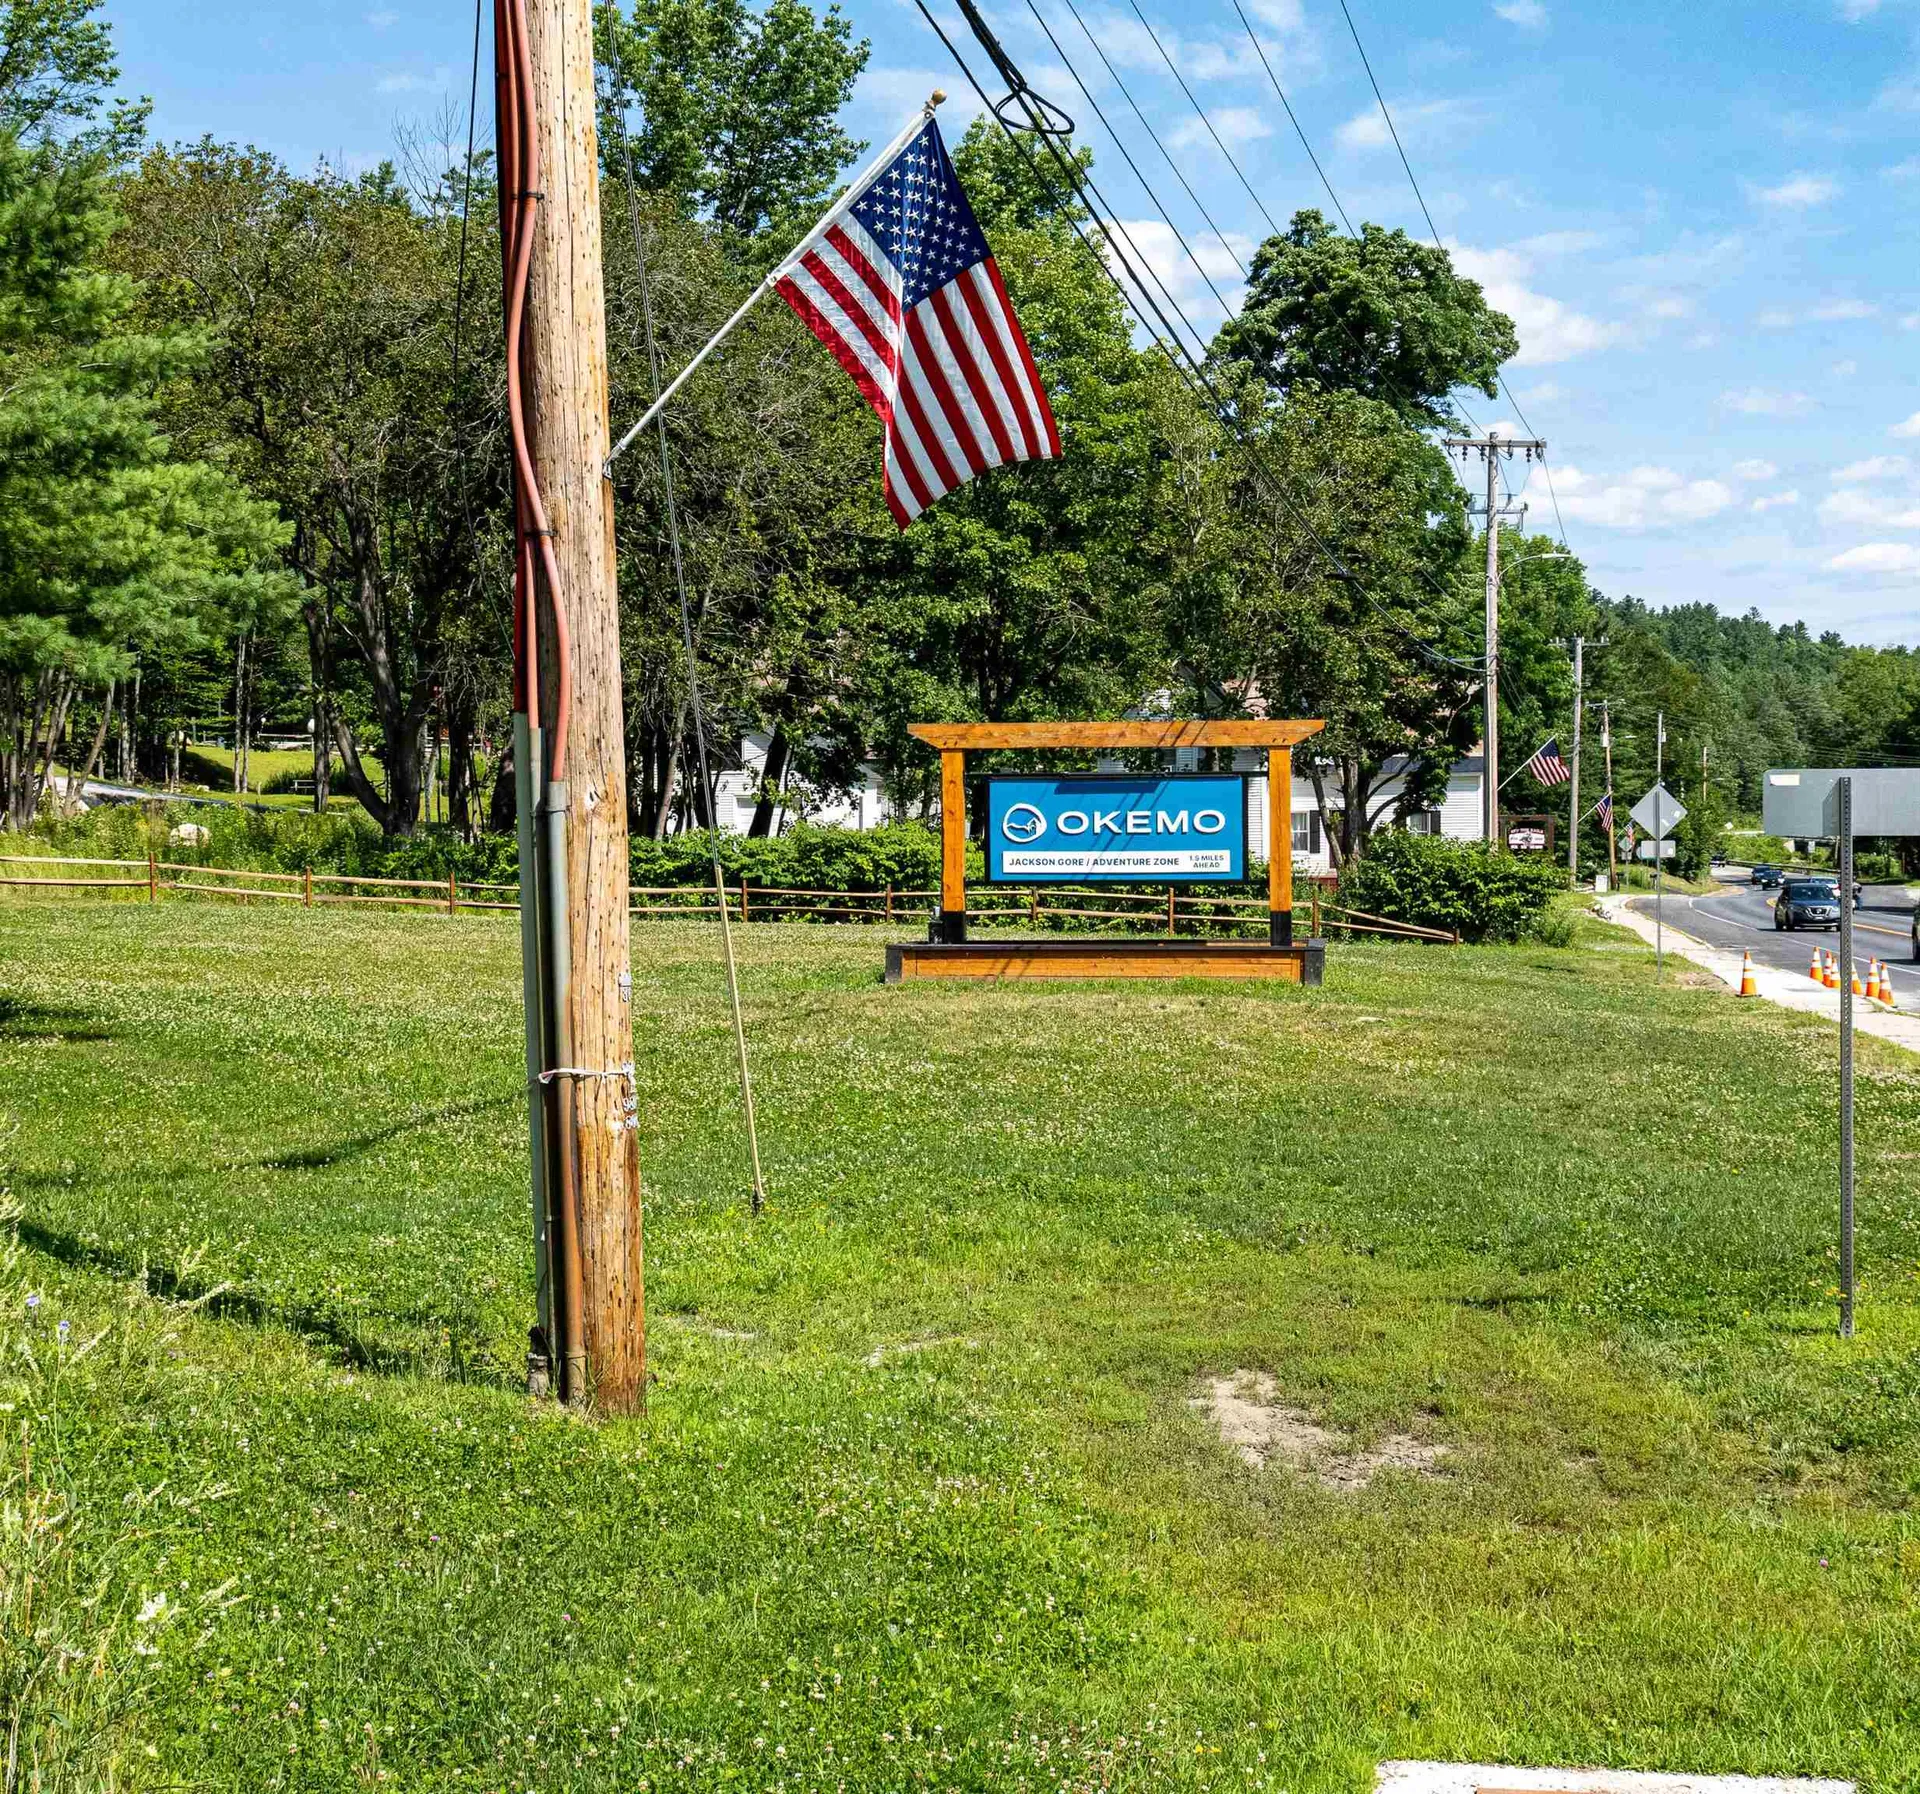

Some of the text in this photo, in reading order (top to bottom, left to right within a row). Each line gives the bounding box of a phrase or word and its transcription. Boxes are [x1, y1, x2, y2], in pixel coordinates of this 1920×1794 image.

[1057, 810, 1226, 834] OKEMO
[1009, 858, 1055, 866] JACKSON
[1058, 858, 1084, 866] GORE
[1093, 858, 1151, 866] ADVENTURE
[1153, 858, 1179, 866] ZONE
